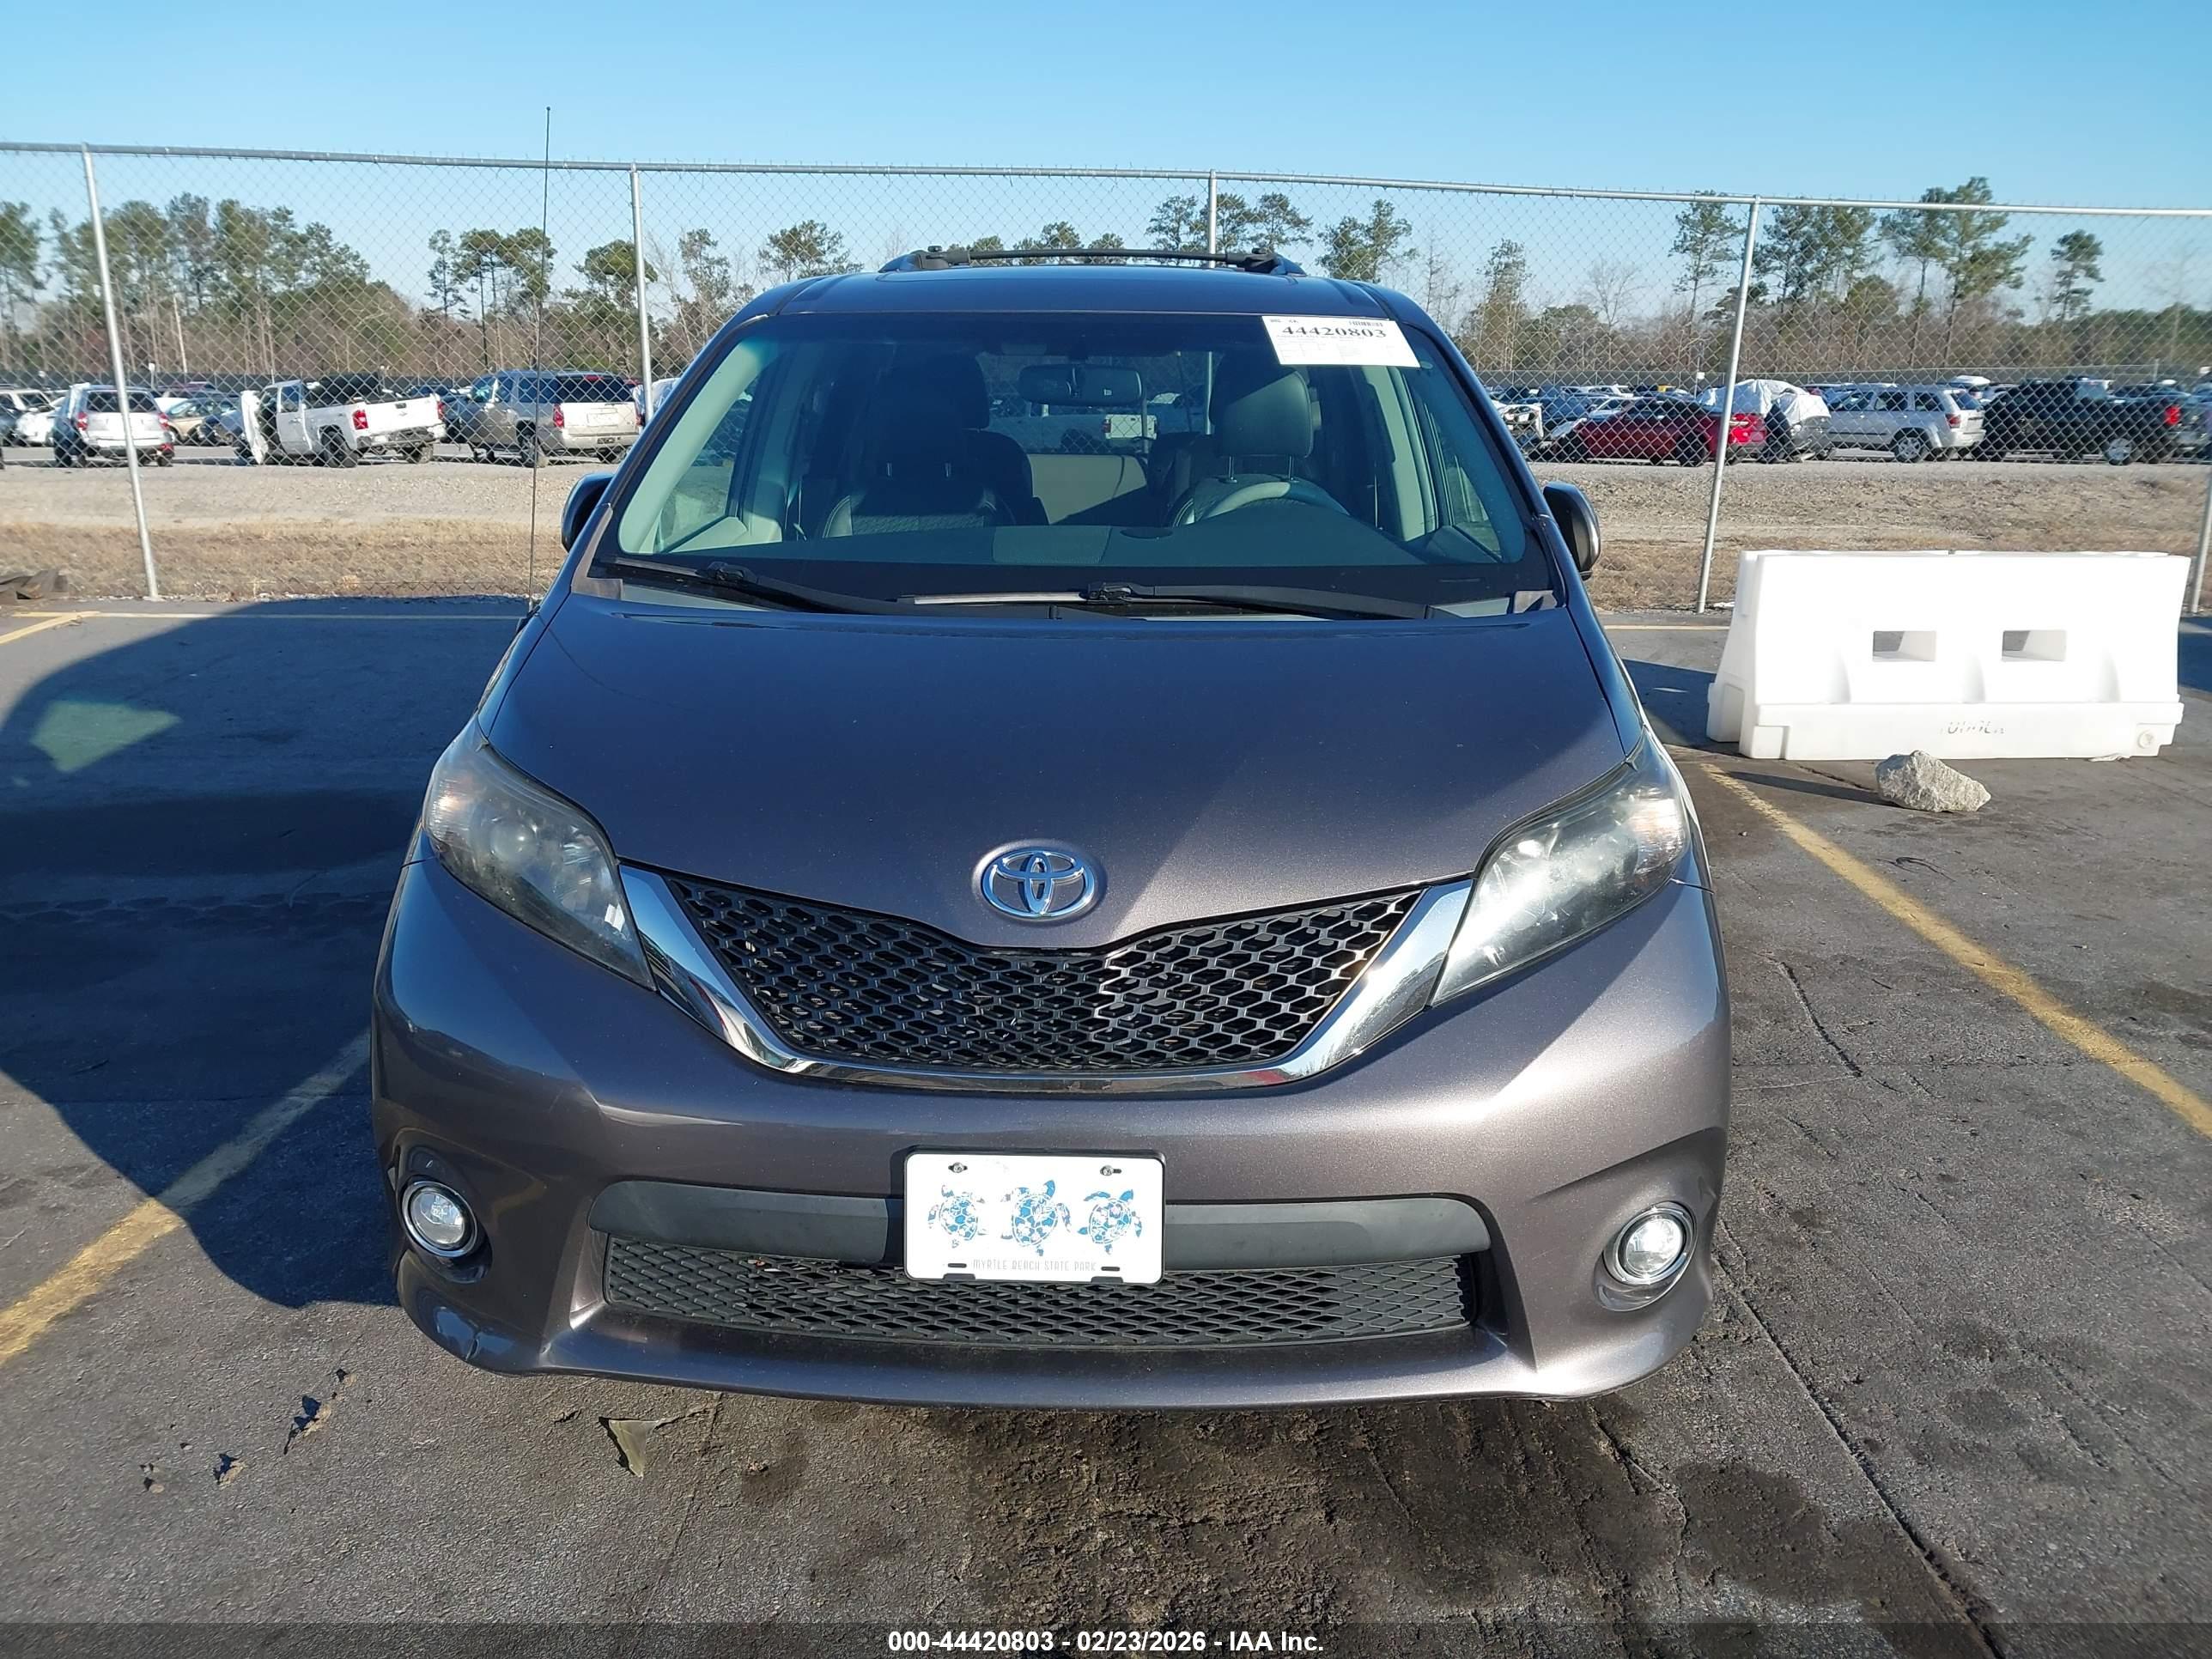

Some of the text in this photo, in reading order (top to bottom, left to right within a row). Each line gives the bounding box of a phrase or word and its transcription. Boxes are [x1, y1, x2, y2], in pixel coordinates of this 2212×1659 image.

[1282, 325, 1387, 338] 44420803
[972, 1259, 1097, 1272] MYRTLE BEACH STATE PARK
